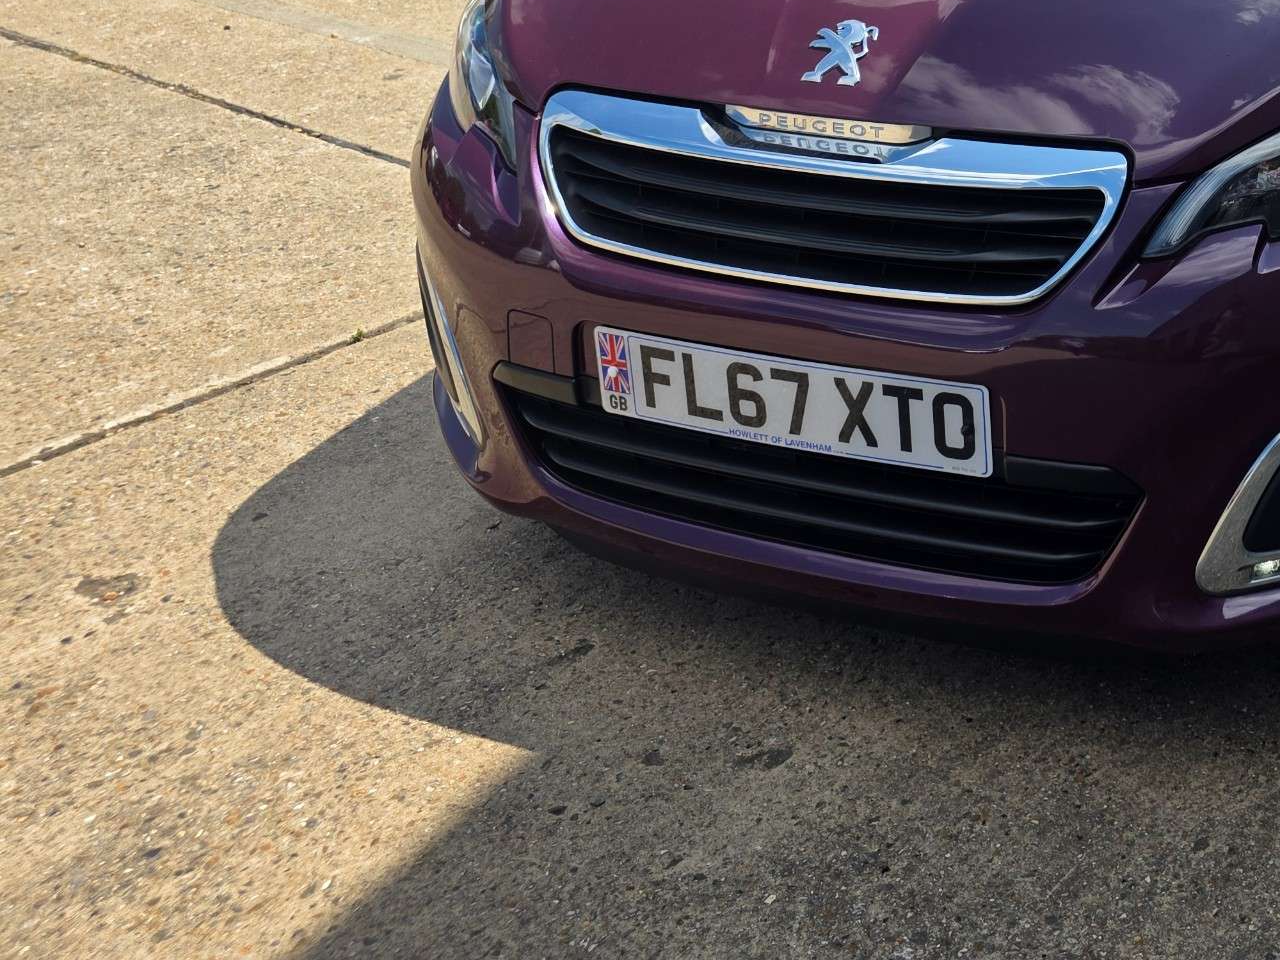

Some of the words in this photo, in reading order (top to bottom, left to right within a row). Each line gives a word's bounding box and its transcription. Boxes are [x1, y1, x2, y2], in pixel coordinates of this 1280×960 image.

[759, 113, 885, 139] PEUGEOT
[609, 394, 628, 412] GB
[639, 344, 810, 436] FL67
[833, 376, 976, 461] XTO
[728, 428, 769, 441] HOWLETT
[771, 436, 783, 444] OF
[784, 438, 833, 453] LAVENHAM
